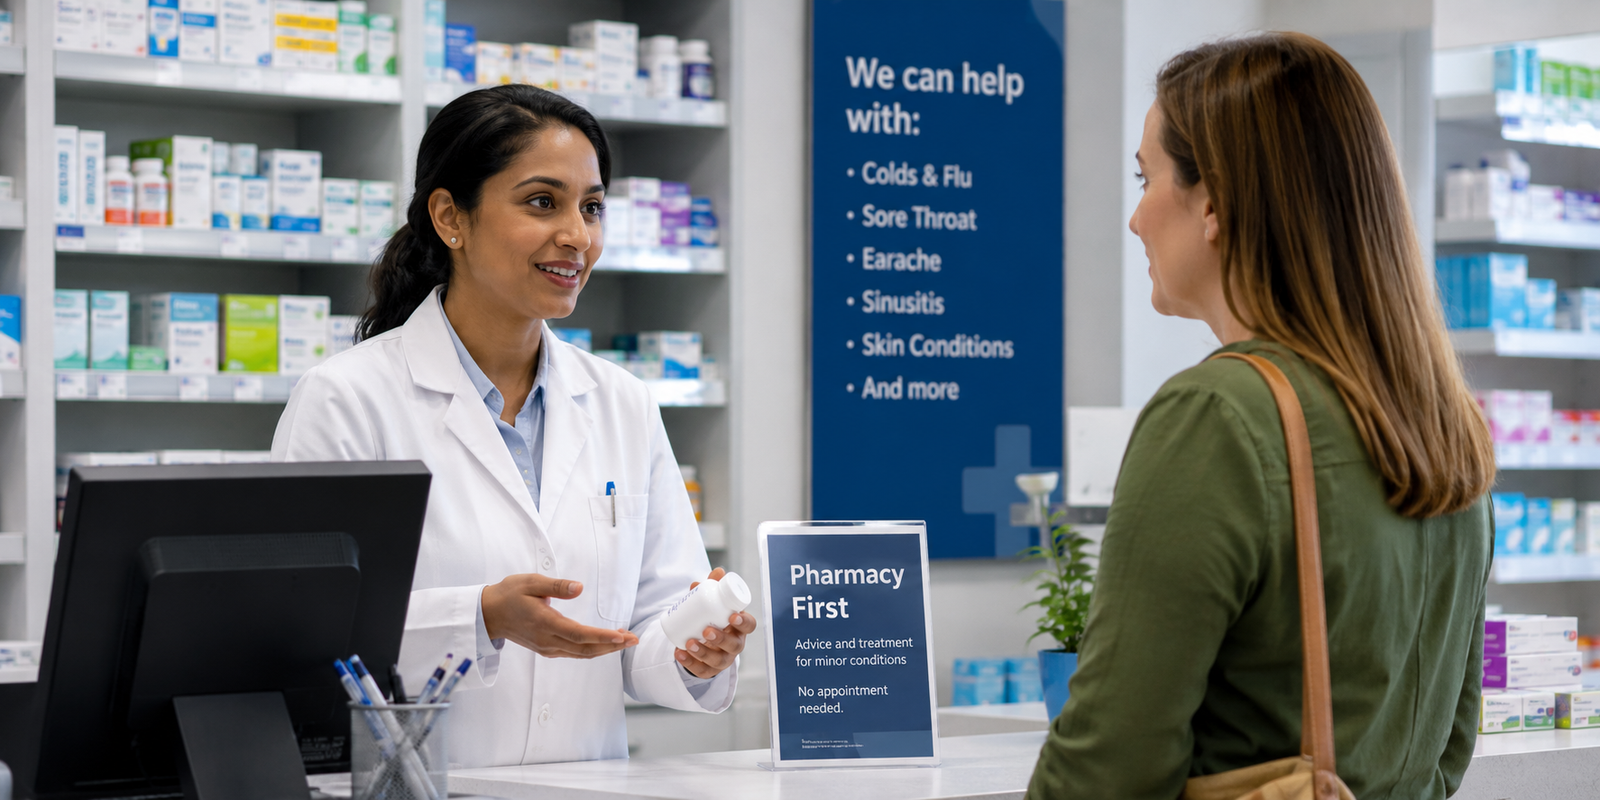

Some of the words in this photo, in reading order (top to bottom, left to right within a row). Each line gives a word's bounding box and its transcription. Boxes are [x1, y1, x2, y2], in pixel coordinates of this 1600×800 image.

[846, 57, 895, 90] We
[902, 65, 953, 93] can
[962, 62, 1024, 104] help
[845, 102, 920, 136] with:
[862, 161, 918, 186] Colds
[922, 164, 938, 187] &
[943, 165, 972, 188] Flu
[862, 203, 908, 228] Sore
[911, 205, 977, 231] Throat
[862, 246, 942, 272] Earache
[862, 289, 945, 315] Sinusitis
[862, 332, 905, 356] Skin
[909, 333, 1014, 358] Conditions
[861, 376, 903, 400] And
[907, 381, 960, 400] more
[790, 563, 905, 590] Pharmacy
[792, 595, 850, 620] First
[794, 638, 832, 650] Advice
[835, 638, 856, 649] and
[858, 637, 914, 649] treatment
[795, 655, 812, 667] for
[815, 655, 847, 667] minor
[850, 654, 907, 666] conditions
[798, 686, 814, 697] No
[817, 685, 888, 699] appointment
[799, 702, 844, 714] needed.
